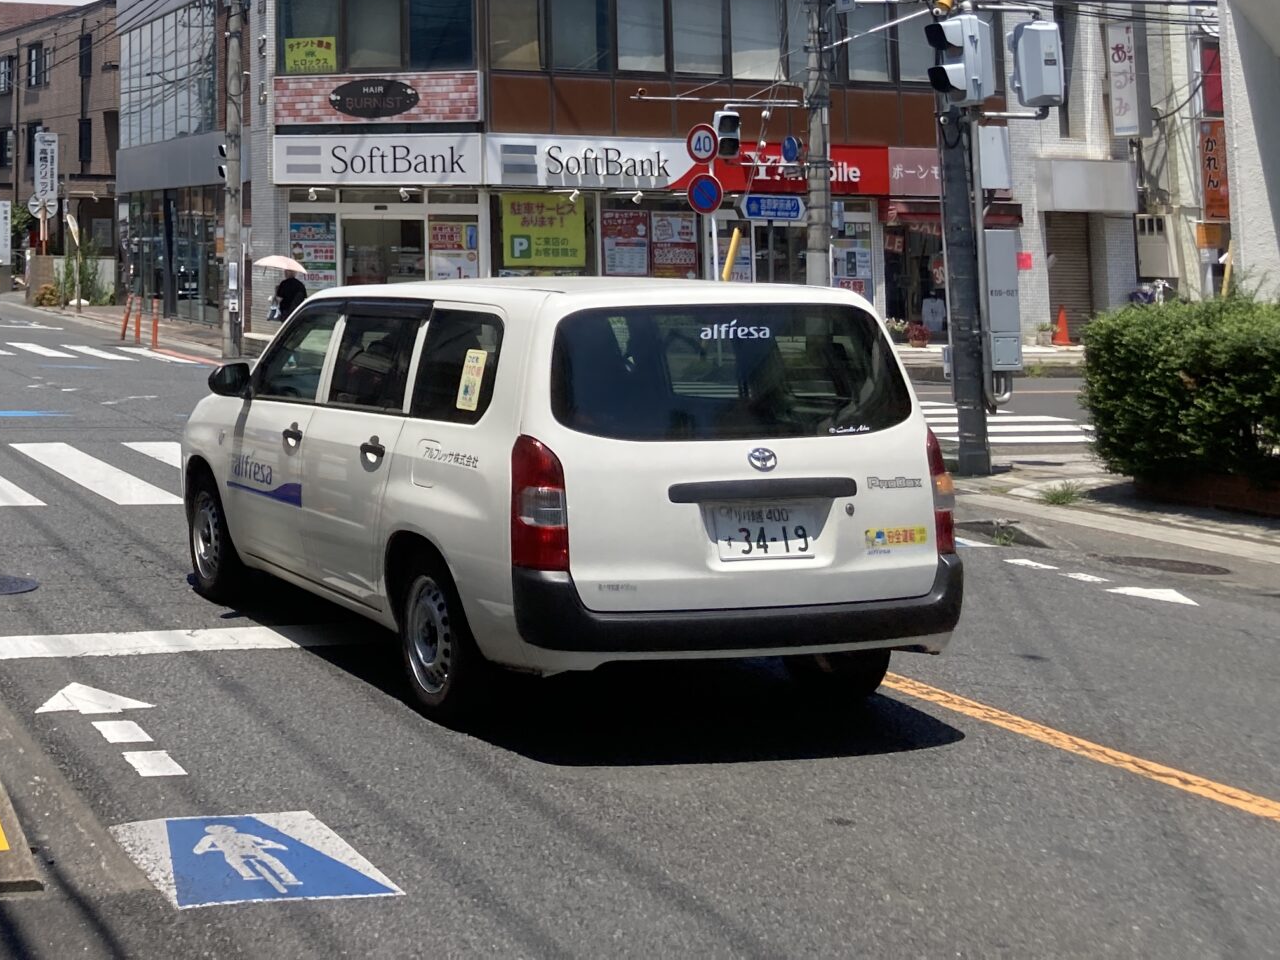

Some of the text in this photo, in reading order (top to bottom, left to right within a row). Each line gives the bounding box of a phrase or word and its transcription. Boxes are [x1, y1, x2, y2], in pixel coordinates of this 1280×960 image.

[362, 86, 384, 94] HAIR
[694, 135, 712, 153] 40
[330, 145, 466, 174] SoftBank
[545, 145, 672, 178] SoftBank
[1204, 137, 1219, 189] かれん
[510, 201, 577, 216] 駐車サービス
[700, 318, 770, 340] alfresa
[234, 449, 273, 486] alfresa
[423, 446, 479, 468] アルフレッサ株式会社
[766, 508, 789, 522] 400
[738, 525, 809, 555] 34-19
